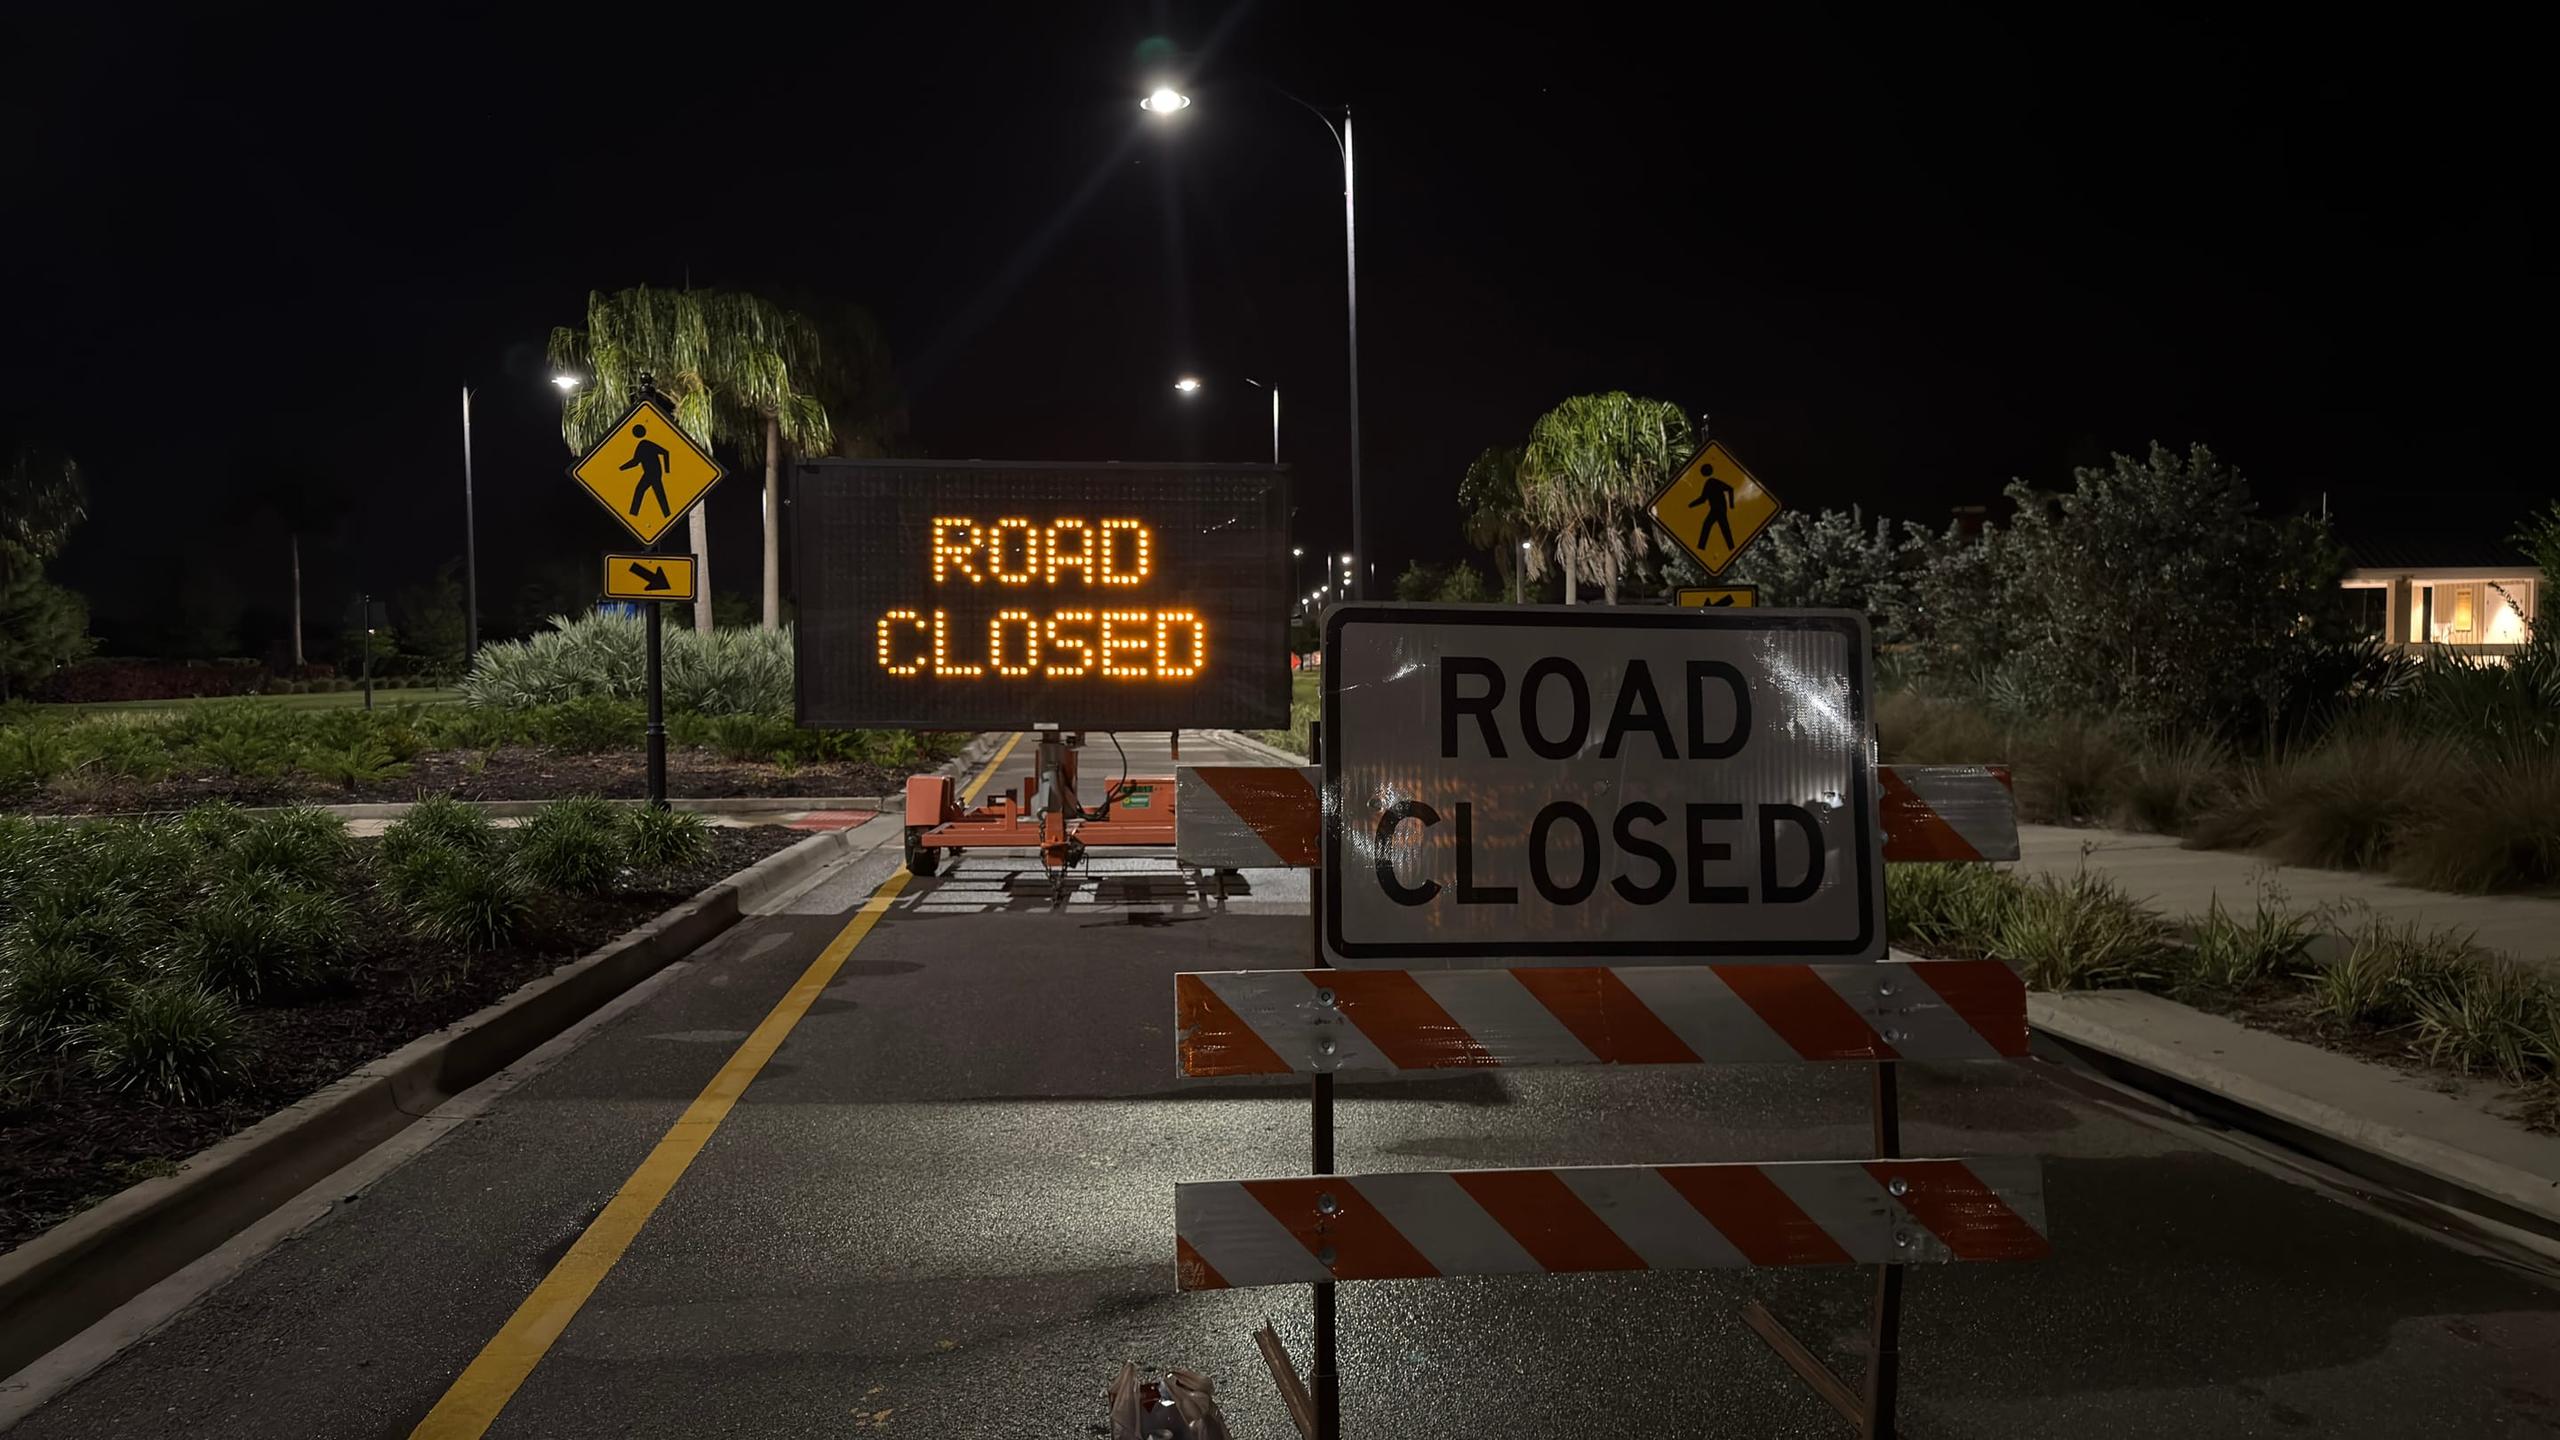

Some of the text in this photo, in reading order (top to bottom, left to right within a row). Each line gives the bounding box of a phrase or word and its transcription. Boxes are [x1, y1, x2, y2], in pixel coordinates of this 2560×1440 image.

[931, 517, 1152, 586] ROAD
[876, 608, 1207, 679] CLOSED
[1441, 656, 1752, 761] ROAD
[1375, 801, 1826, 907] CLOSED
